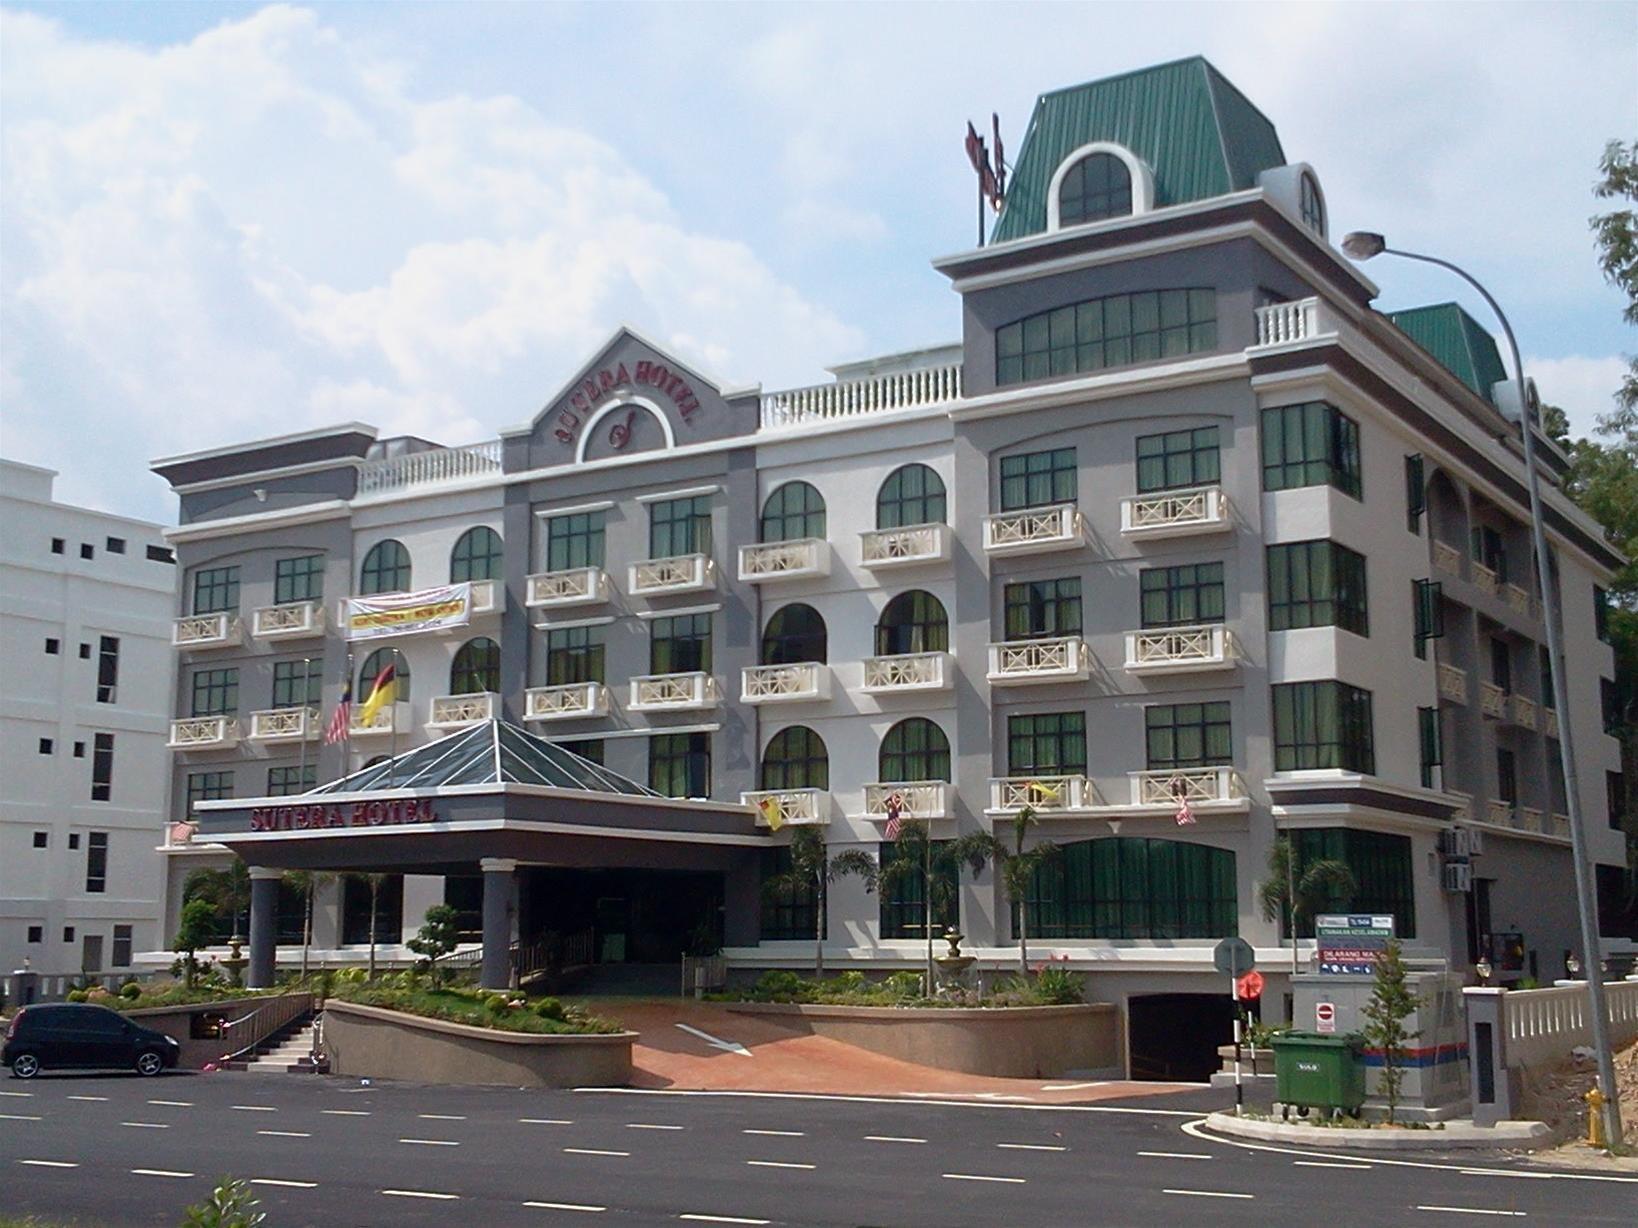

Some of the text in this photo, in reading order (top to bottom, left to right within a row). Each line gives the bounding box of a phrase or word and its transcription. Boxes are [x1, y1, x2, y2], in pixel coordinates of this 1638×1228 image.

[635, 360, 700, 424] HOTEL
[250, 799, 438, 831] SUTERA HOTEL
